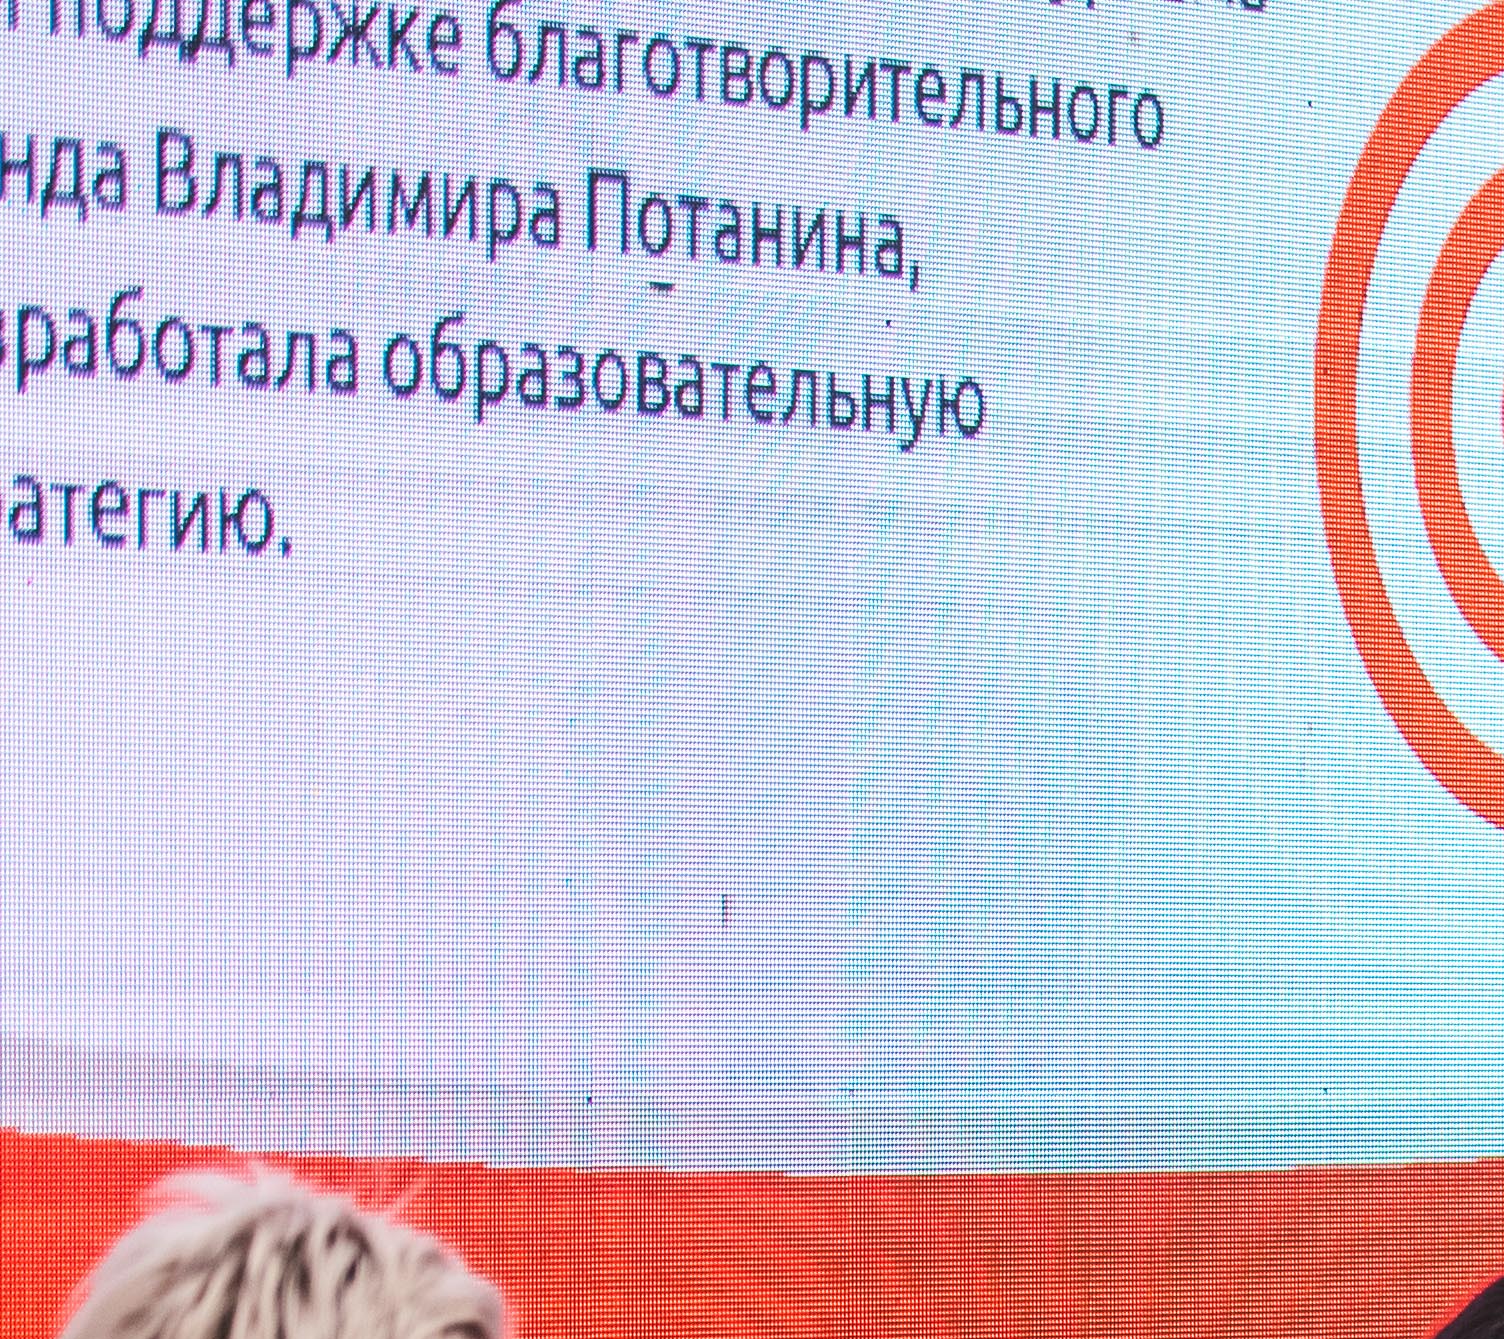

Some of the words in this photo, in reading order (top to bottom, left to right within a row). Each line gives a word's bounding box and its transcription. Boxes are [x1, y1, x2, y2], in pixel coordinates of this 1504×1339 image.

[48, 0, 462, 79] поддержке
[486, 0, 1165, 150] благотворительного
[155, 125, 560, 263] Владимира
[587, 167, 920, 292] Потанина,
[0, 285, 359, 397] работала
[384, 311, 986, 453] образовательную
[8, 474, 293, 559] атегию.
